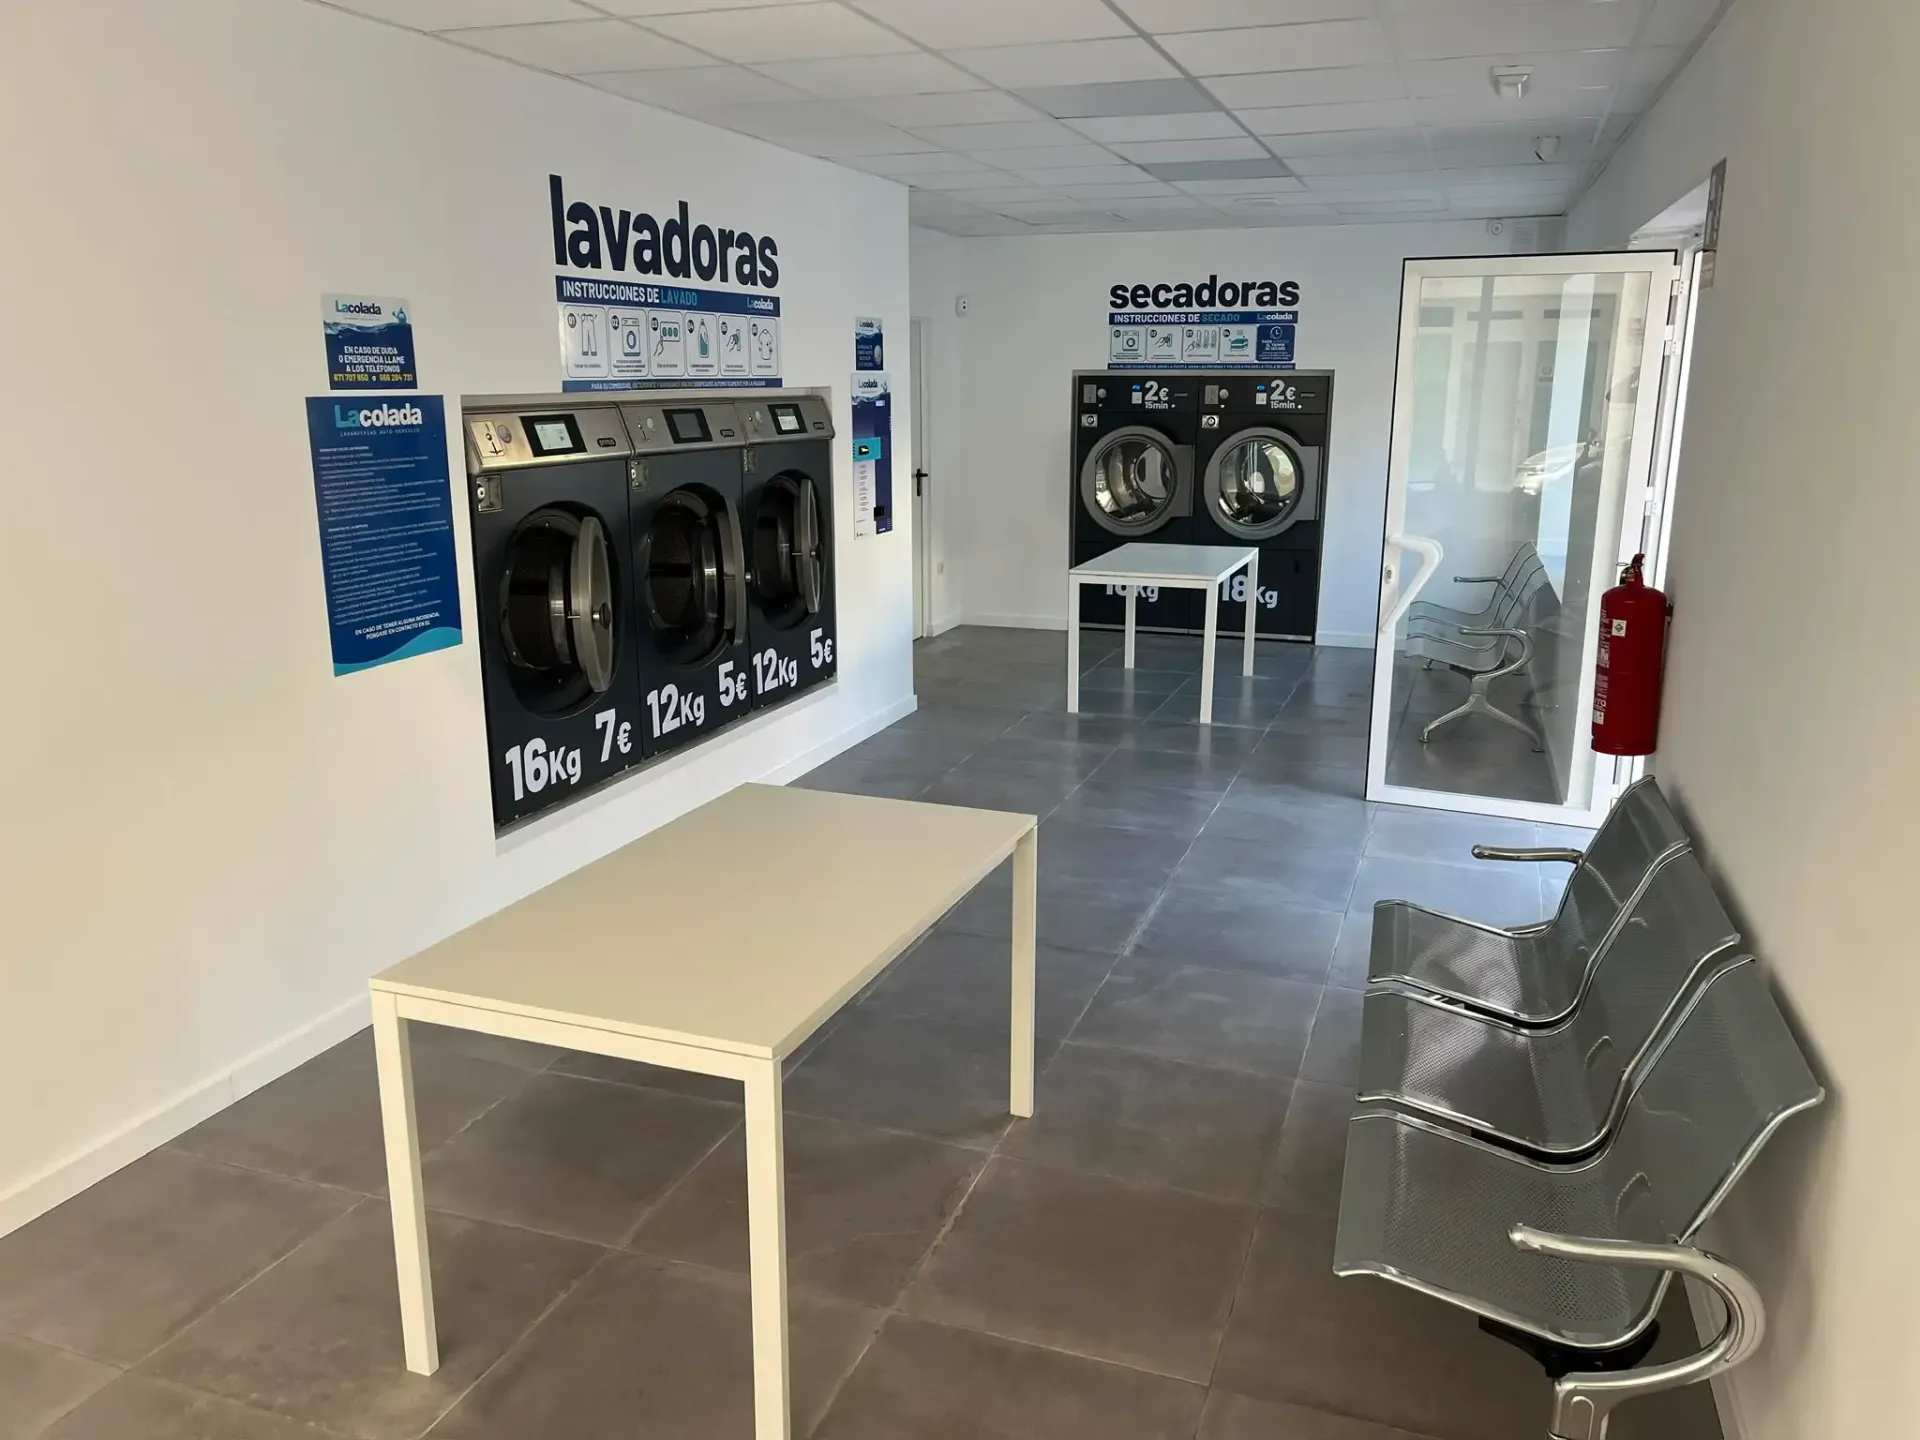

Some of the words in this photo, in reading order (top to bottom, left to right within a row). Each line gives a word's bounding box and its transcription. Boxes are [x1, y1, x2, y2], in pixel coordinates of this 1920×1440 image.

[549, 174, 779, 289] lavadoras
[562, 280, 645, 302] INSTRUCCIONES
[647, 288, 660, 304] DE
[660, 289, 698, 305] LAVADO
[1109, 274, 1300, 309] secadoras
[335, 299, 382, 315] Lacolada
[1256, 312, 1293, 321] Lacolada
[1114, 313, 1187, 323] INSTRUCCIONES
[1187, 313, 1200, 323] DE
[1201, 313, 1240, 323] SECADO
[344, 346, 353, 354] EN
[354, 346, 371, 354] CASO
[381, 347, 398, 355] DUDA
[344, 355, 383, 364] EMERGENCIA
[384, 356, 405, 364] LLAME
[352, 365, 365, 373] LOS
[1144, 381, 1169, 401] 2€
[1270, 379, 1297, 400] 2€
[1144, 401, 1169, 409] 15min
[1270, 400, 1295, 409] 15min
[334, 403, 423, 428] Lacolada
[362, 626, 376, 634] CASO
[383, 620, 397, 629] TENER
[397, 617, 415, 625] ALGUNA
[395, 622, 418, 633] CONTACTO
[810, 627, 833, 669] 5€
[752, 648, 797, 695] 12Kg
[717, 660, 747, 707] 5€
[646, 683, 705, 738] 12Kg
[595, 708, 632, 764] 7€
[505, 737, 582, 802] 16Kg
